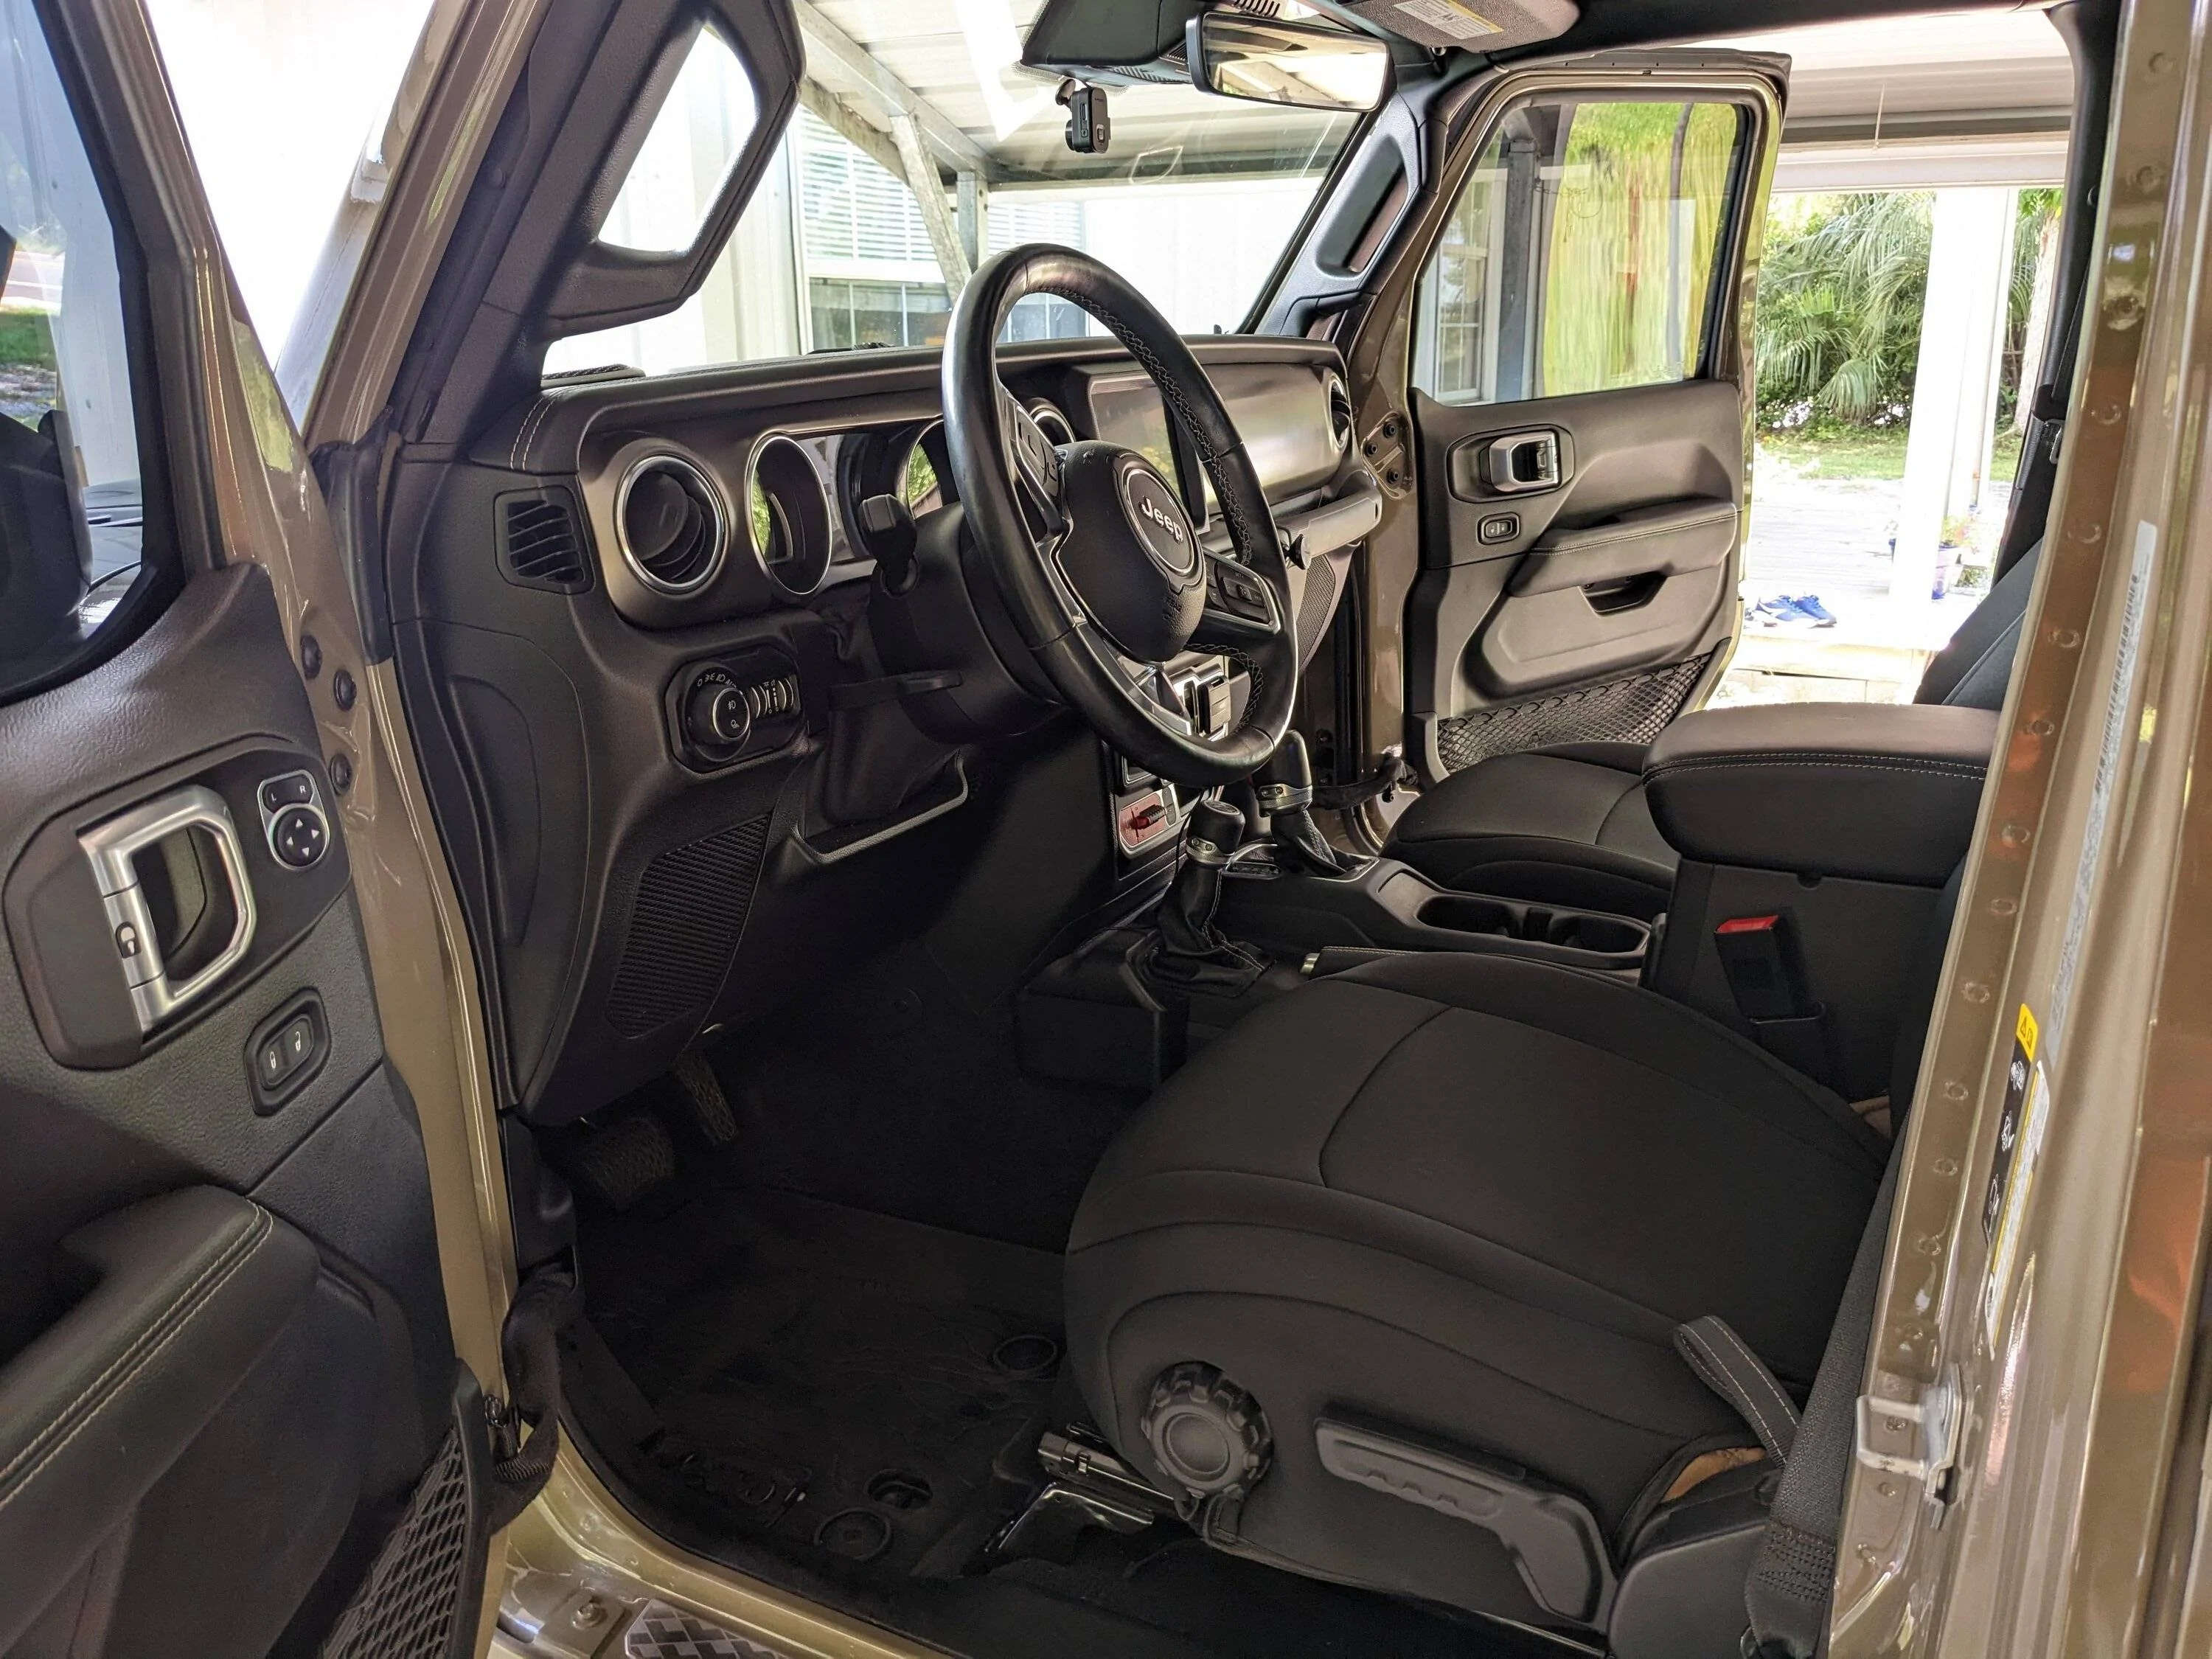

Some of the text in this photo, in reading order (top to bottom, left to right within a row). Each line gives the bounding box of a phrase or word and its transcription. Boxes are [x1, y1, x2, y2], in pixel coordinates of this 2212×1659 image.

[1140, 497, 1183, 543] Jeep
[299, 785, 306, 793] R
[271, 793, 277, 801] L
